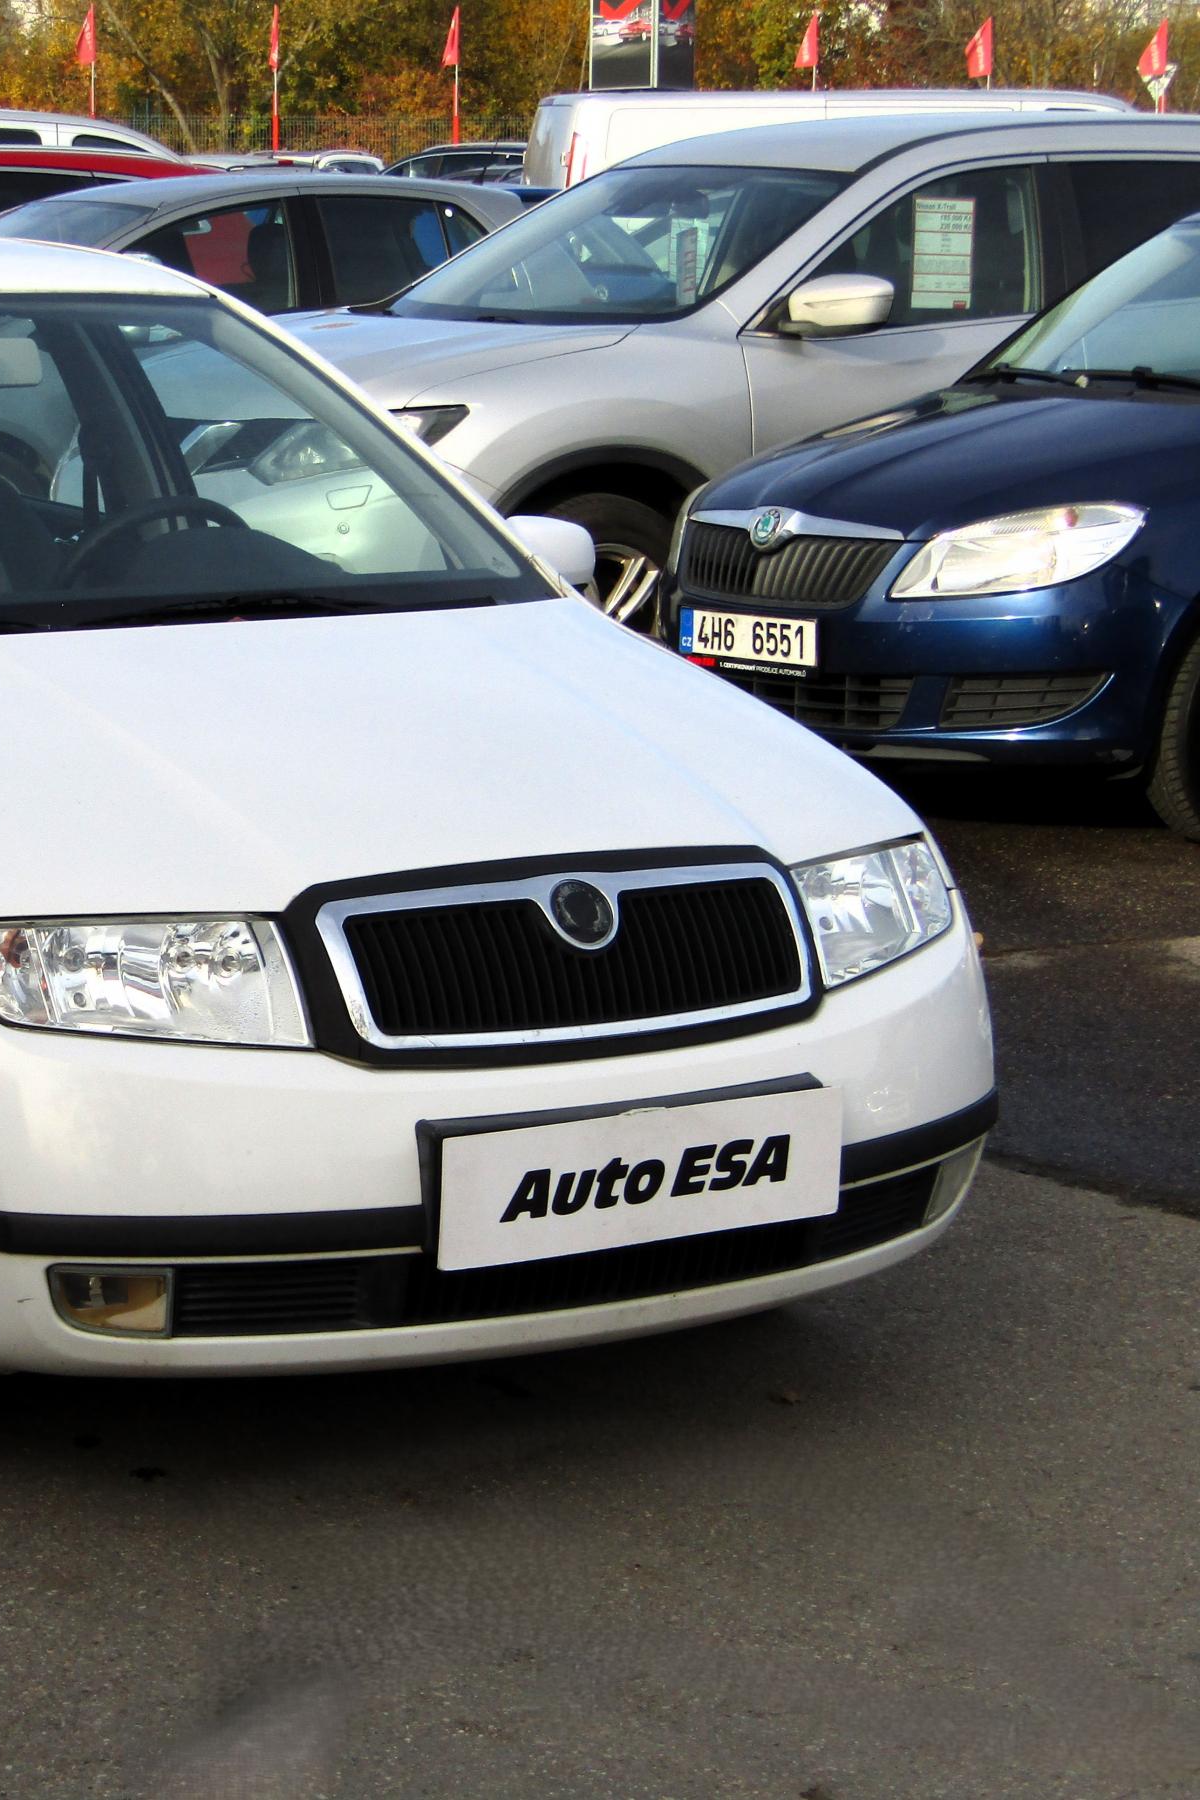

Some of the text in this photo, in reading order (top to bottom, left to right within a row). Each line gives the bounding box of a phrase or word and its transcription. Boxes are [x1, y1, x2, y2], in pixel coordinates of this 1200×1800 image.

[681, 636, 692, 647] CZ
[697, 616, 804, 660] 4H6 6551
[499, 1134, 791, 1224] Auto ESA
